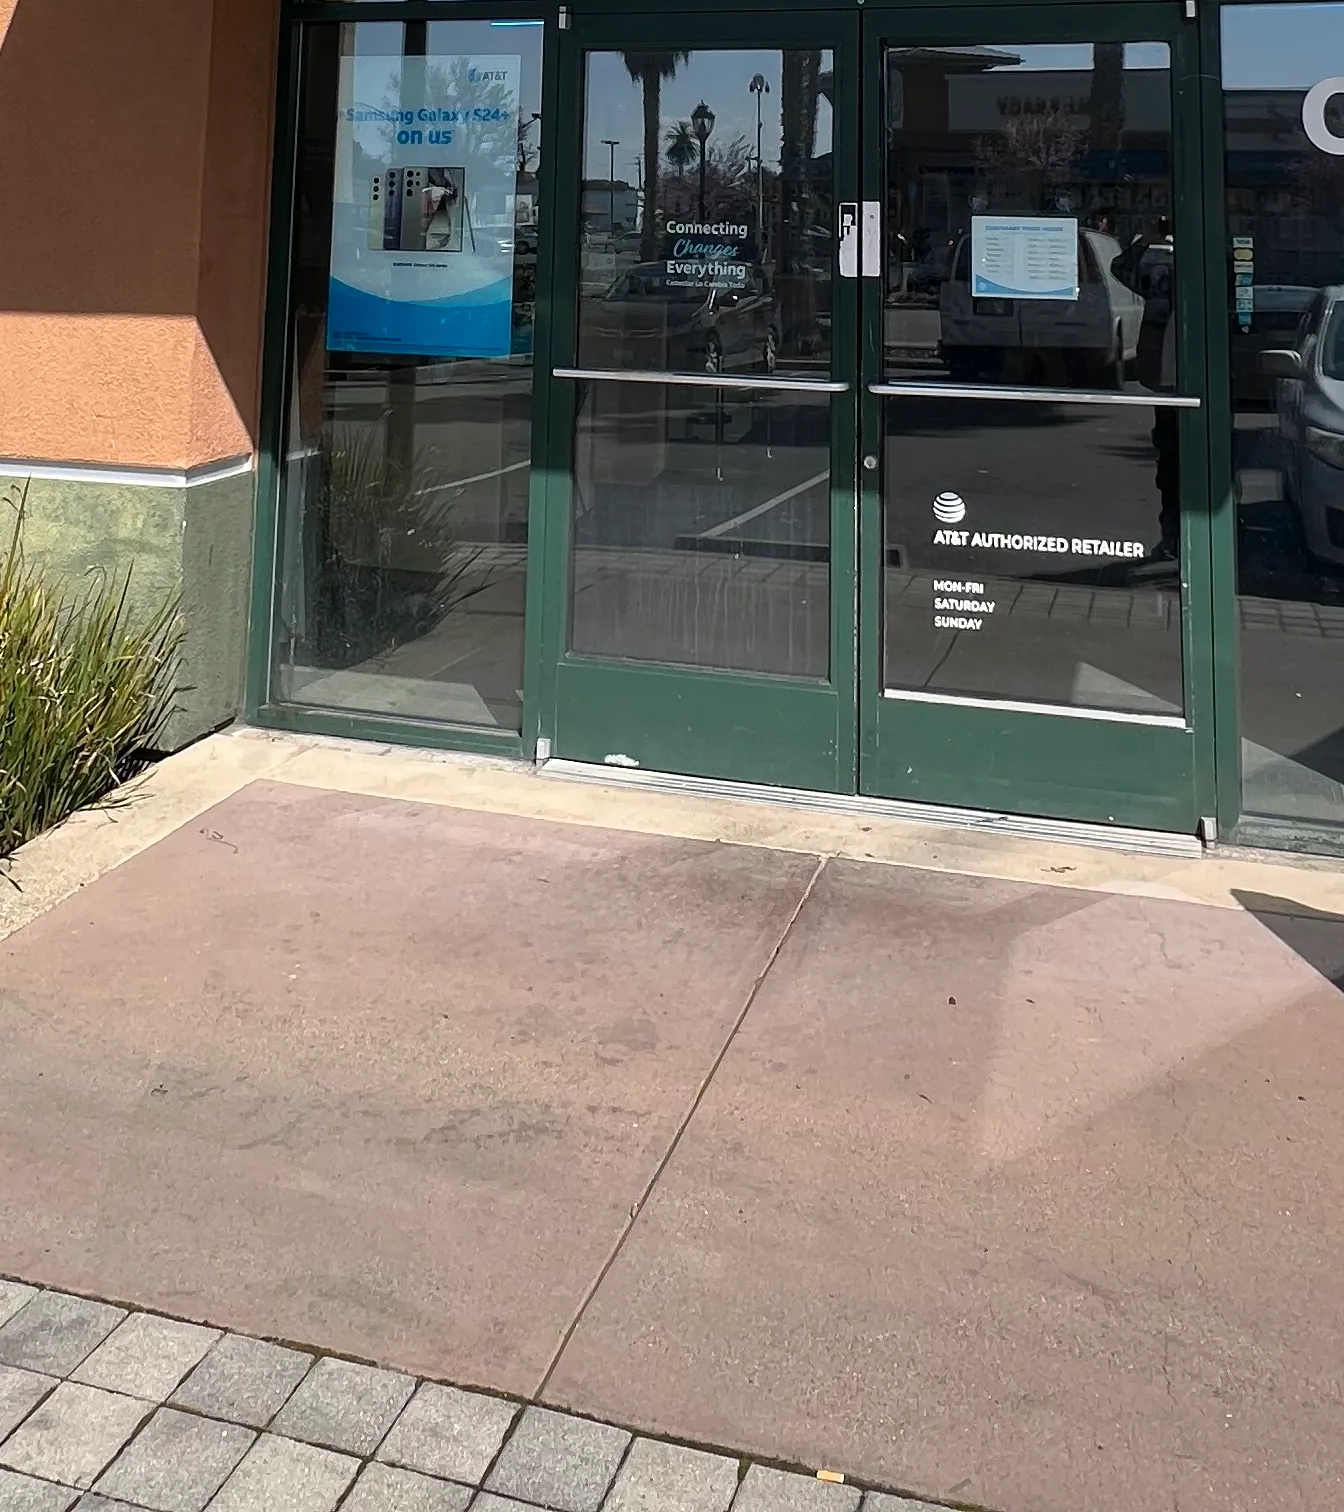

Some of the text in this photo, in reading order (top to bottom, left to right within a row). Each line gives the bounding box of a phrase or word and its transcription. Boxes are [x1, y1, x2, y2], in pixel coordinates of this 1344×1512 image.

[482, 70, 508, 81] AT&T
[396, 129, 453, 145] on us
[666, 220, 748, 239] Connecting
[673, 238, 739, 259] Changes
[666, 260, 746, 280] Everything
[933, 529, 1145, 558] AT&T AUTHORIZED RETAILER
[933, 579, 985, 594] MON-FRI
[933, 597, 997, 614] SATURDAY
[933, 615, 984, 630] SUNDAY
